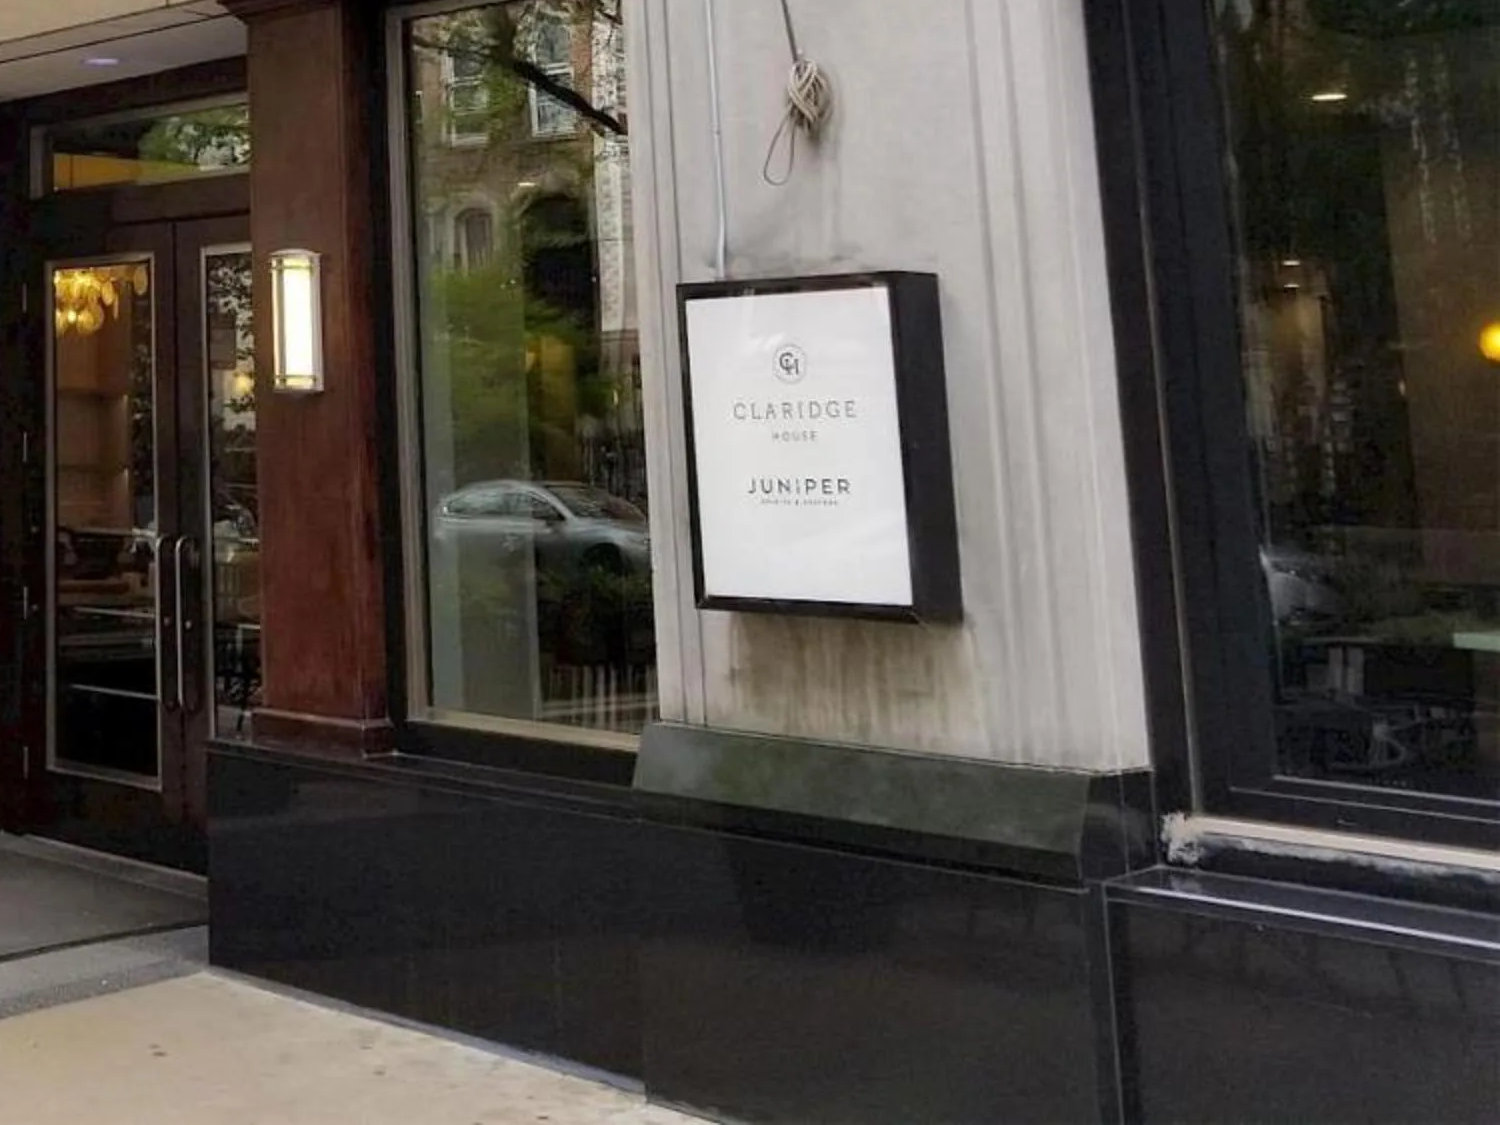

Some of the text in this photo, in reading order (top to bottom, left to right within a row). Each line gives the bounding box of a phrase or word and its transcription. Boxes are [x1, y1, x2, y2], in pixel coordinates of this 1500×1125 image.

[733, 400, 857, 420] CLARIDGE
[772, 430, 819, 442] HOUSE
[748, 478, 851, 495] JUNIPER
